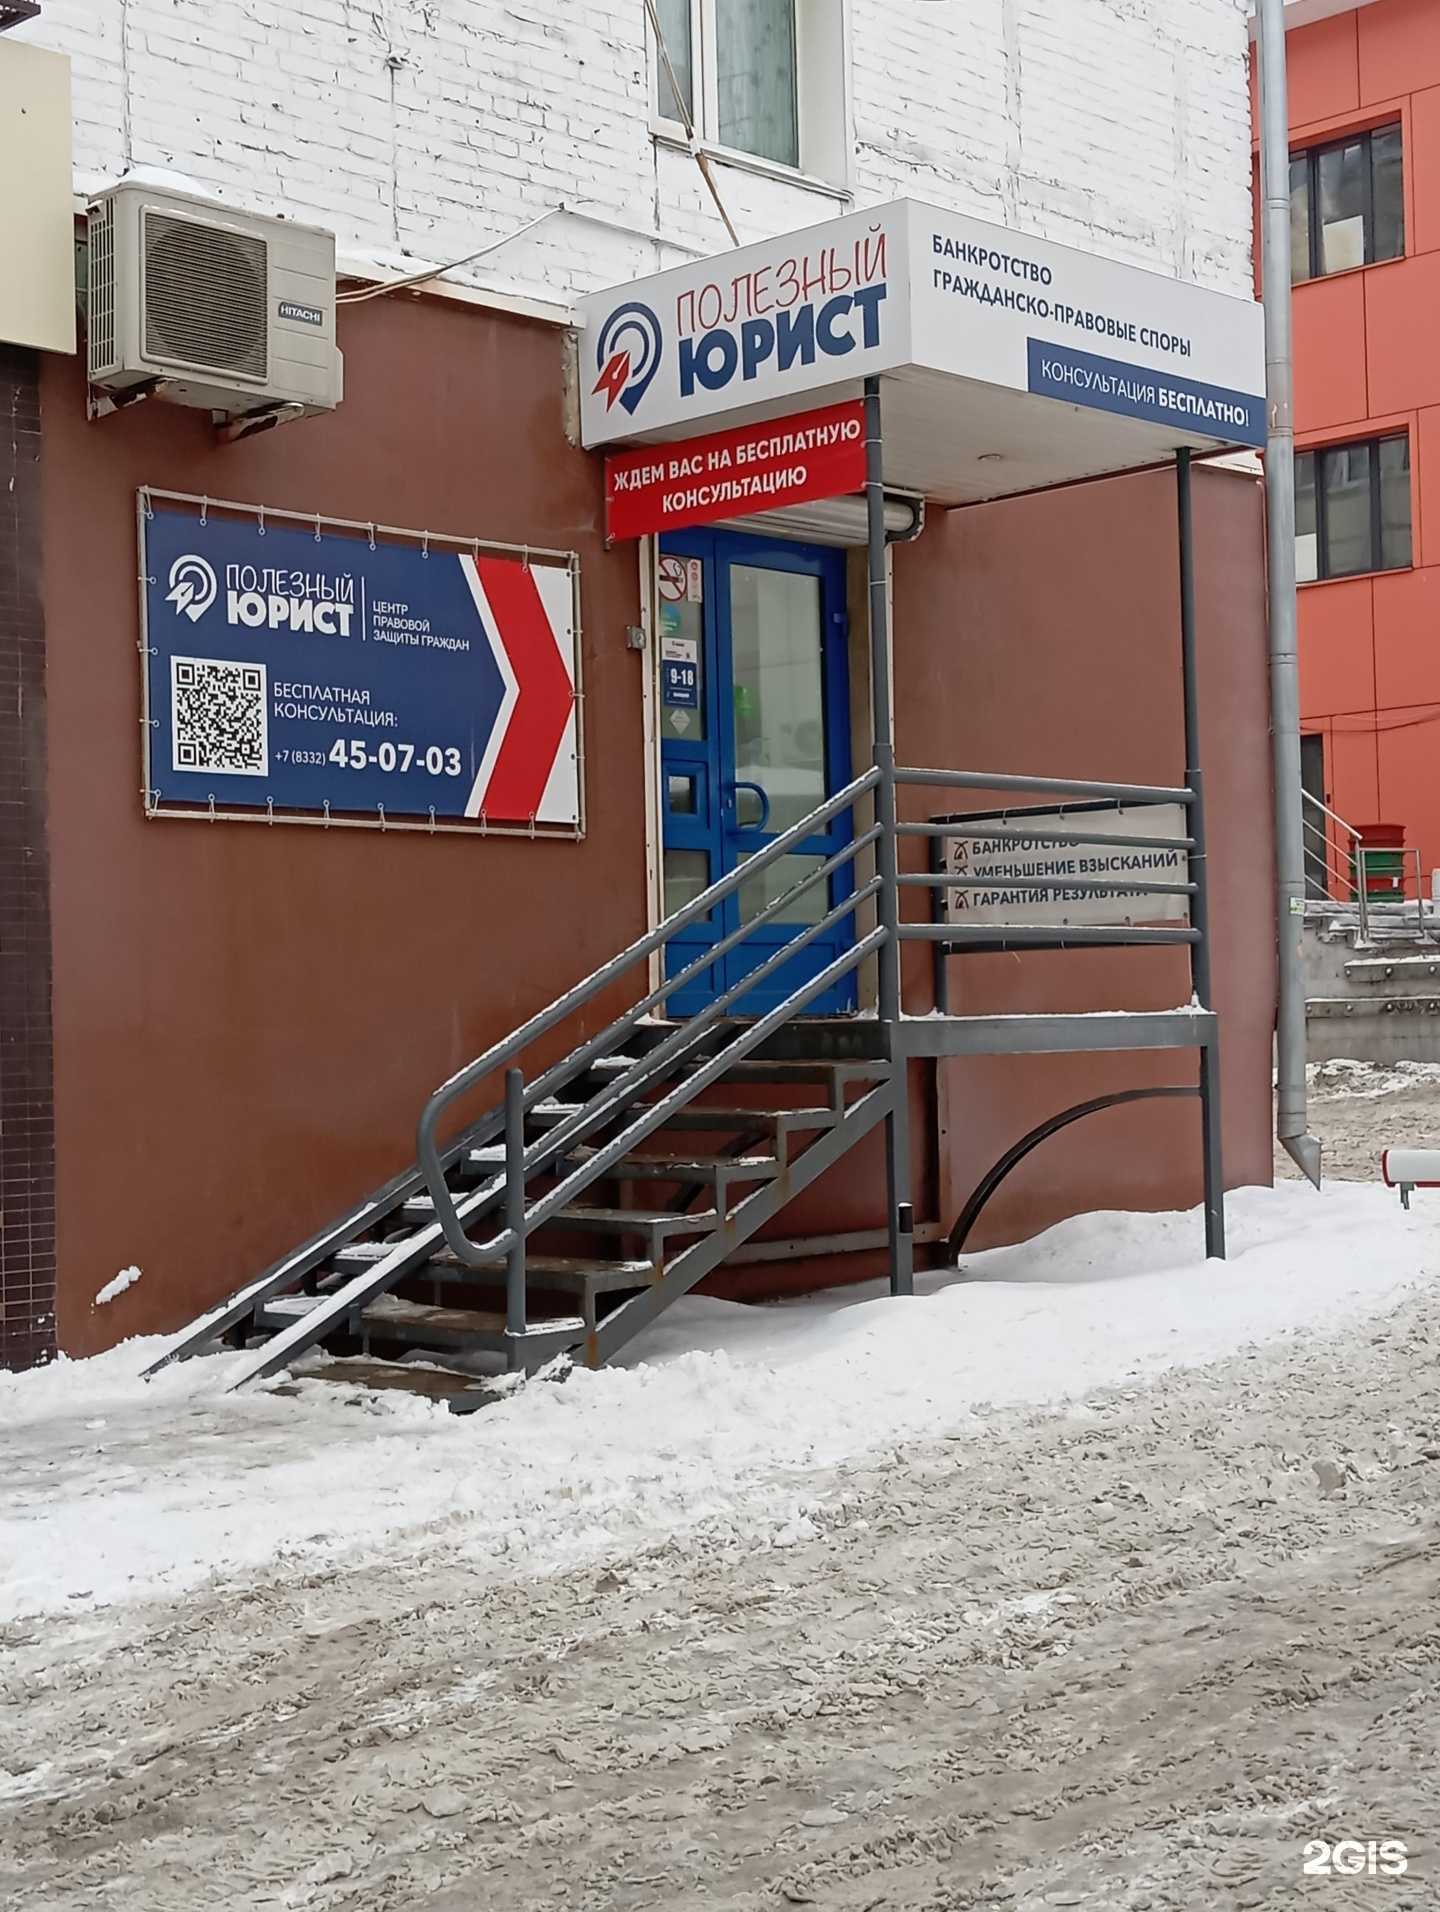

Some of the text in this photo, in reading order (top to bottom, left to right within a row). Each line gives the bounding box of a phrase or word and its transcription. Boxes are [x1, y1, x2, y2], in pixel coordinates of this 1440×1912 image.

[932, 233, 1052, 286] БАНКРОТСТВО
[676, 223, 887, 336] ПОЛЕЗНЫЙ
[281, 304, 321, 322] HITACHI
[933, 269, 1191, 357] ГРАЖДАНСКО-ПРАВОВЫЕ СПОРЫ
[677, 282, 887, 398] ЮРИСТ
[1041, 358, 1249, 427] КОНСУЛЬТАЦИЯ БЕСПЛАТНО!
[614, 419, 861, 492] ЖДЕМ ВАС НА БЕСПЛАТНУЮ
[662, 466, 807, 513] КОНСУЛЬТАЦИЮ
[226, 564, 354, 604] ПОЛЕЗНЫЙ
[227, 589, 354, 637] ЮРИСТ
[372, 600, 409, 615] ЦЕНТР
[373, 615, 430, 632] ПРАВОВОЙ
[373, 630, 470, 652] ЗАЩИТЫ ГРАЖДАН
[274, 681, 370, 705] БЕСПЛАТНАЯ
[670, 668, 694, 686] 9-18
[274, 702, 399, 728] КОНСУЛЬТАЦИЯ:
[274, 739, 462, 777] +7 (8332) 45-07-03
[1079, 848, 1178, 873] ВЗЫСКАНИЙ
[973, 888, 1049, 906] ГАРАНТИЯ
